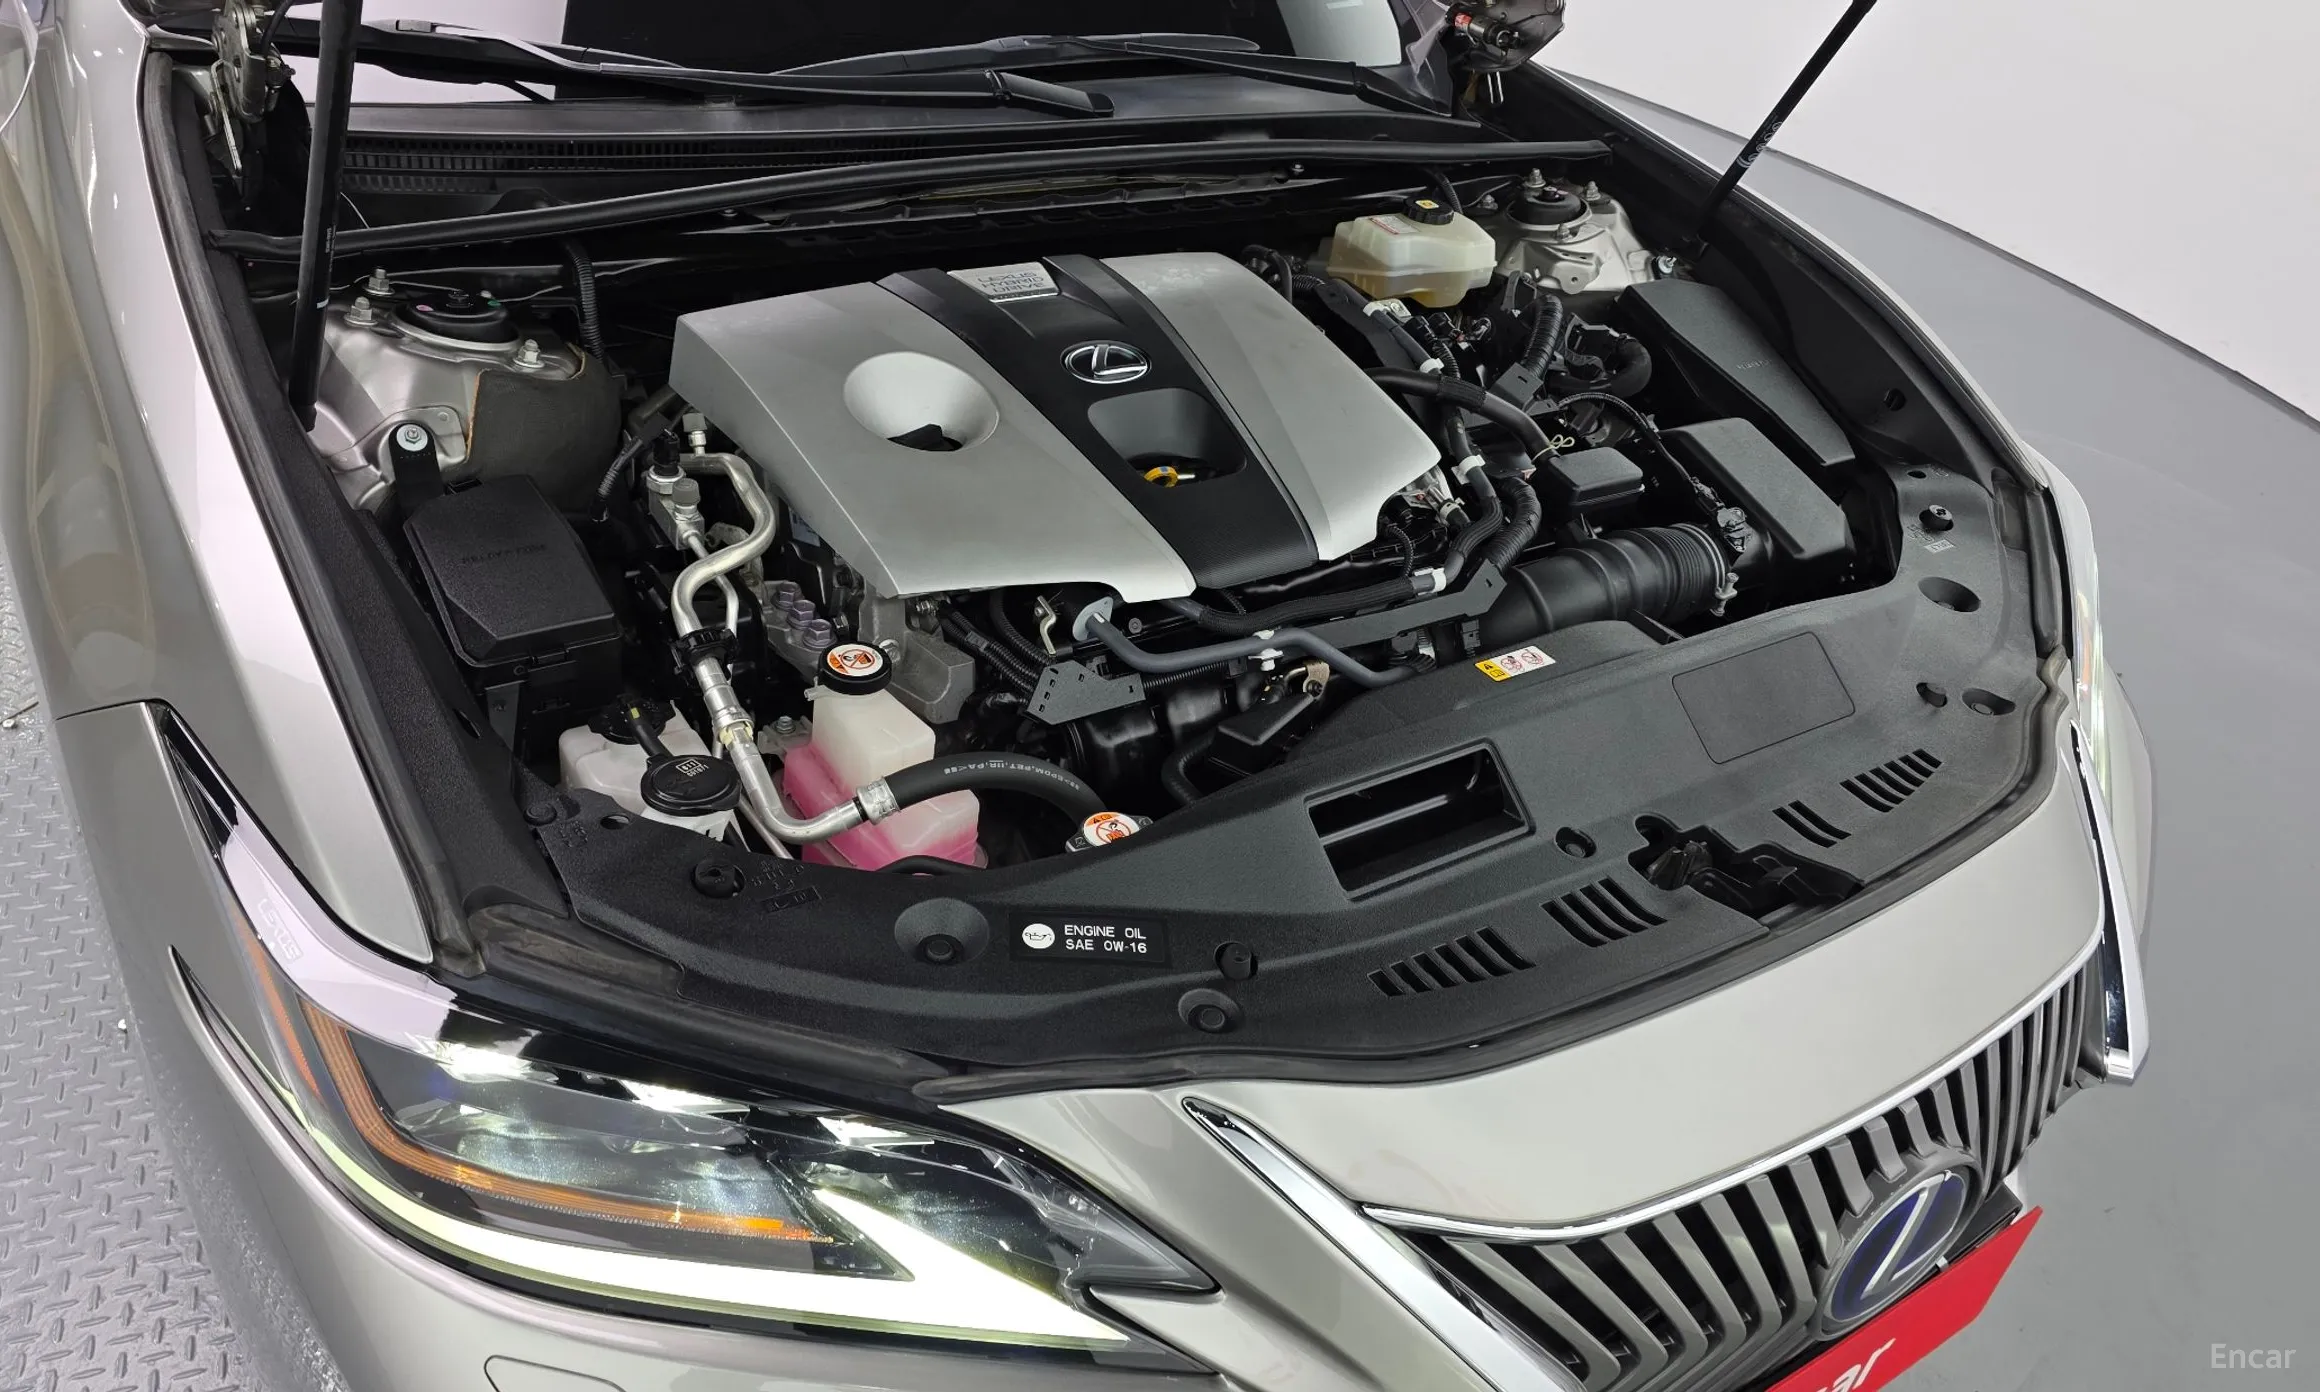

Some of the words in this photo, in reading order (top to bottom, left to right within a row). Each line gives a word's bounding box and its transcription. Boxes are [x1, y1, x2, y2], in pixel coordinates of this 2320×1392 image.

[977, 272, 1037, 282] LEXUS
[981, 276, 1044, 288] HYBRID
[992, 282, 1044, 292] DRIVE
[1064, 924, 1115, 938] ENGINE
[1124, 927, 1146, 939] OIL
[1065, 939, 1094, 950] SAE
[1103, 940, 1147, 953] 0W-16
